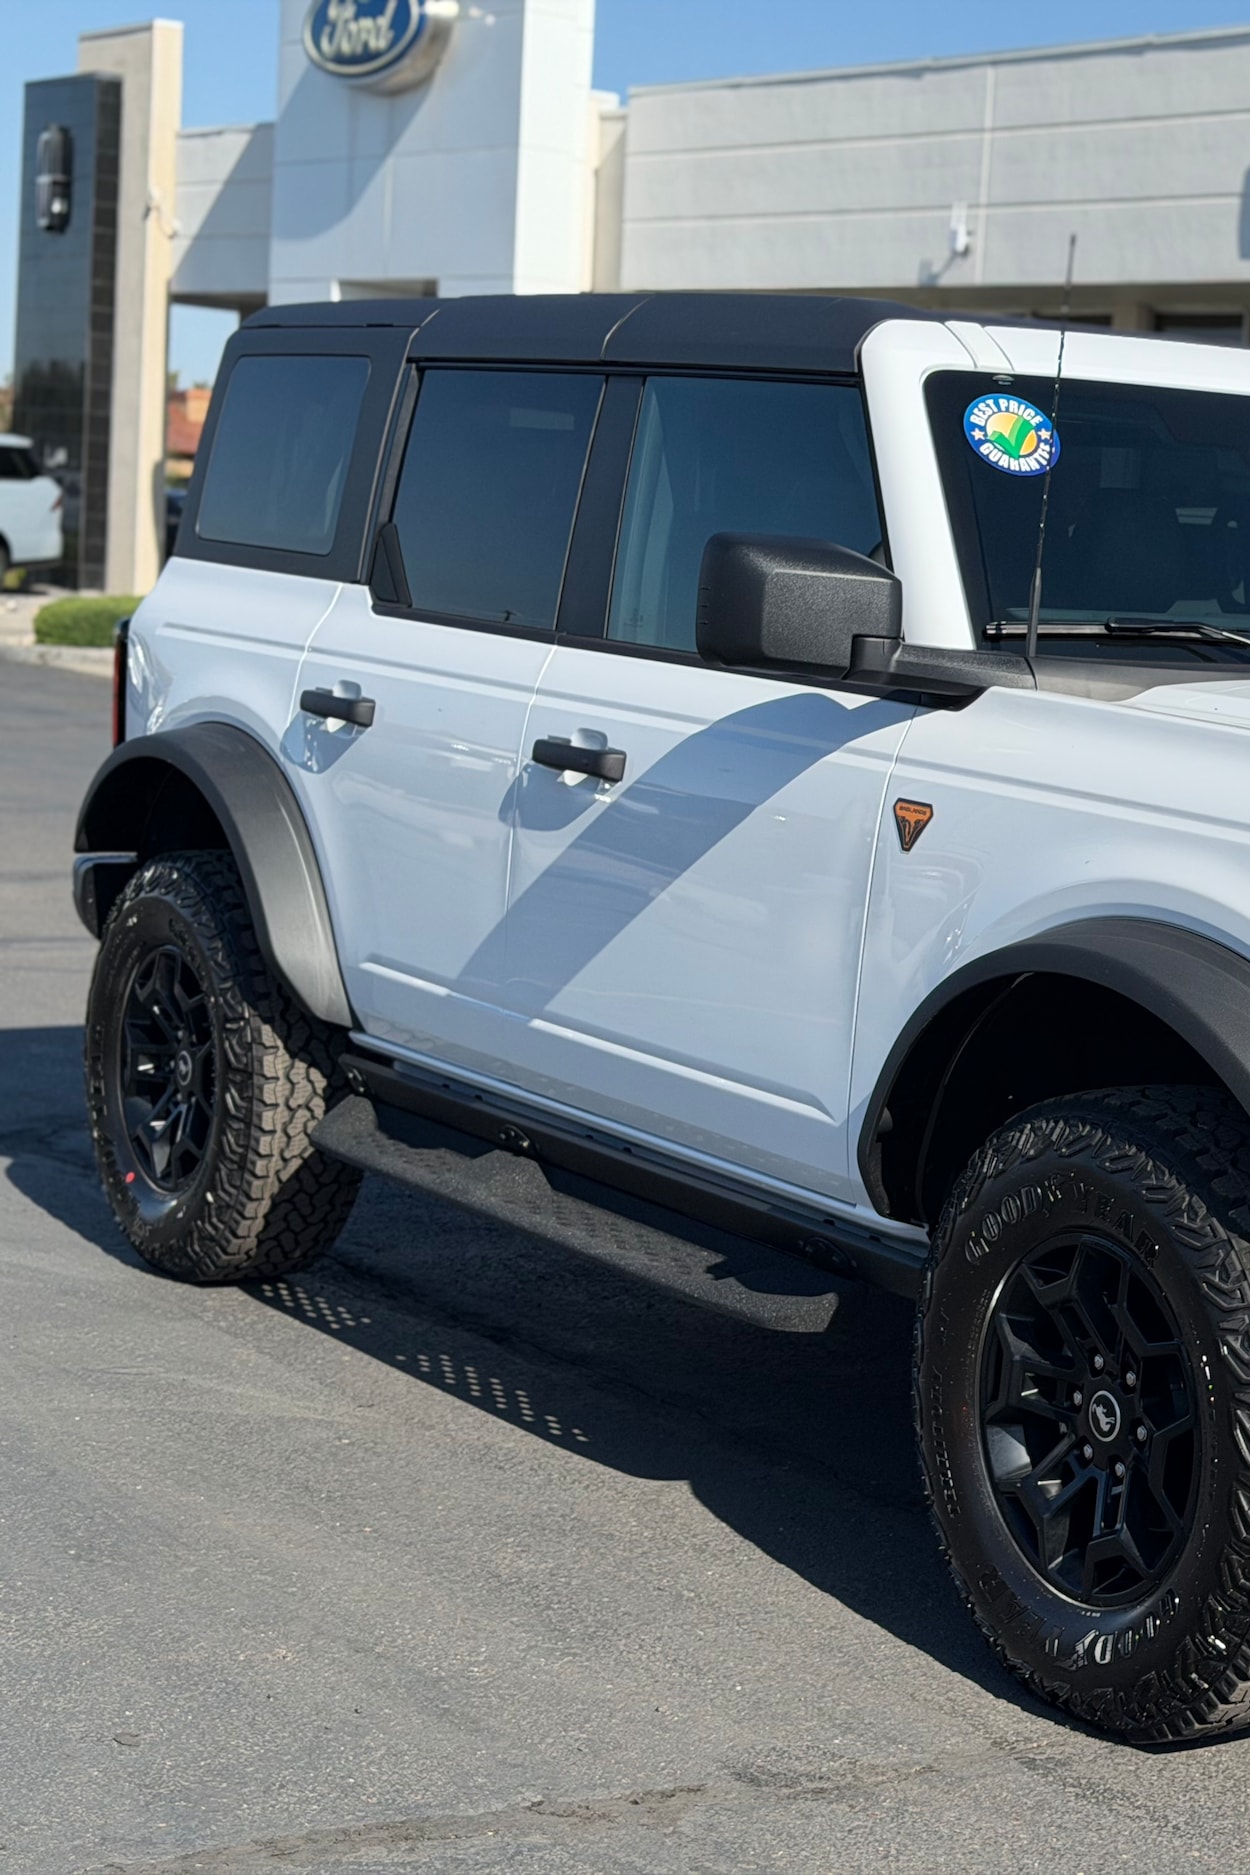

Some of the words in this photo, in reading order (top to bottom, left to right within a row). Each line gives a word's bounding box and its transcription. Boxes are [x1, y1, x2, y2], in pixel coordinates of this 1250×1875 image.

[319, 0, 399, 58] Ford
[969, 398, 998, 427] BEST
[998, 398, 1044, 427] PRICE
